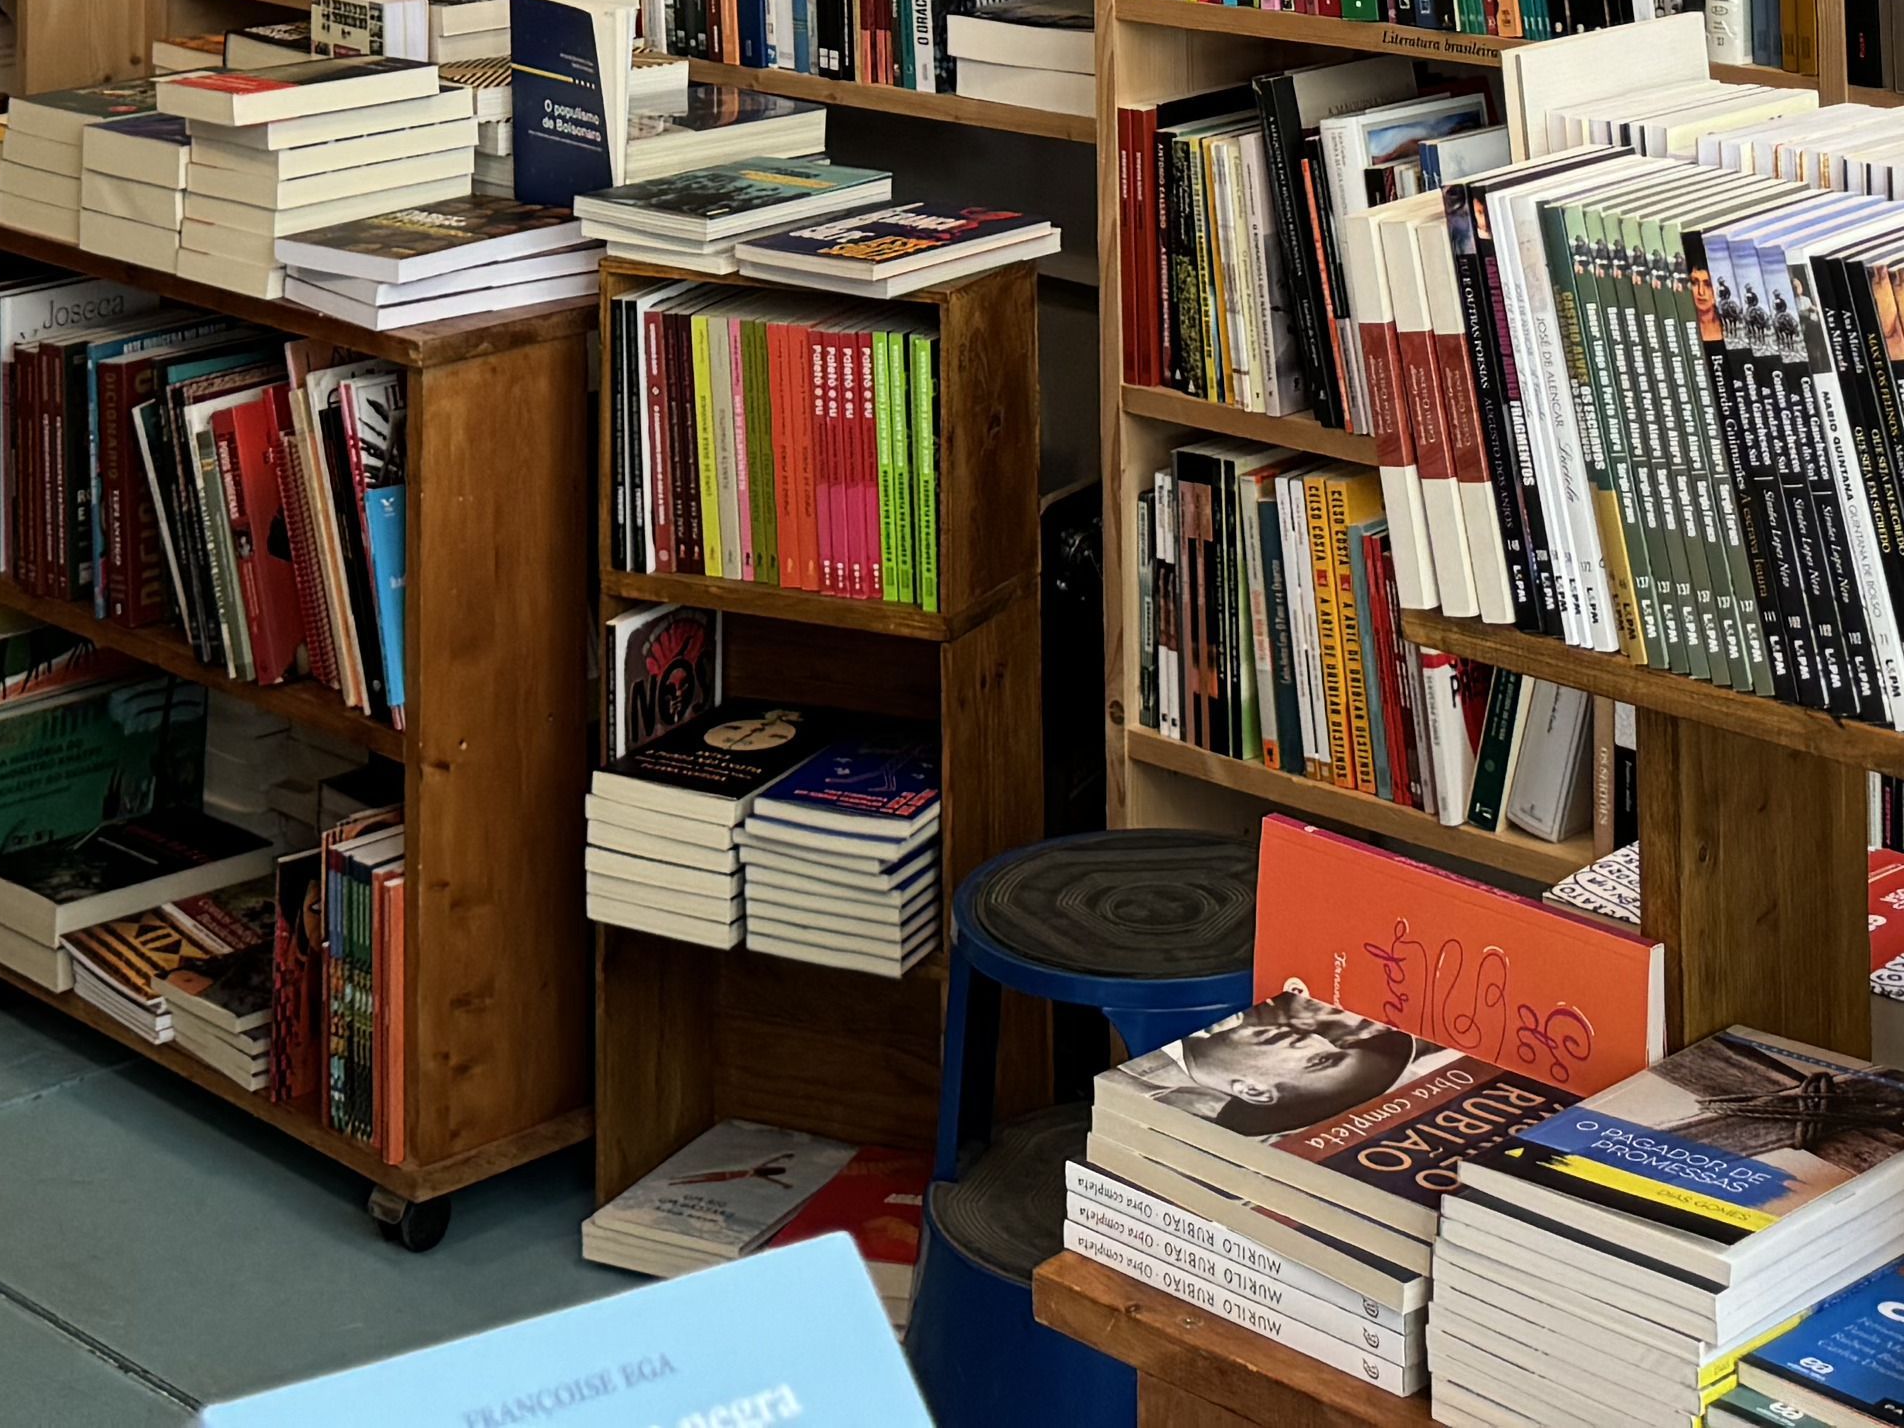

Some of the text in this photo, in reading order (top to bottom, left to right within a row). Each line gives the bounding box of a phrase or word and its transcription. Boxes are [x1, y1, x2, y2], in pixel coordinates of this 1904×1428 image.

[1382, 30, 1499, 59] Literatura brasileira
[554, 102, 601, 126] populismo
[557, 119, 602, 143] Bolsonaro
[41, 288, 128, 332] Joseca
[1304, 1069, 1474, 1152] Obra completa
[1357, 1081, 1547, 1172] RUBIÃO
[1575, 1120, 1772, 1187] O PAGADOR DE
[1590, 1139, 1750, 1194] PROMESSAS
[1695, 1197, 1751, 1223] GOMES
[1164, 1241, 1282, 1305] MURILO RUBIÃO
[618, 1352, 678, 1387] EGA
